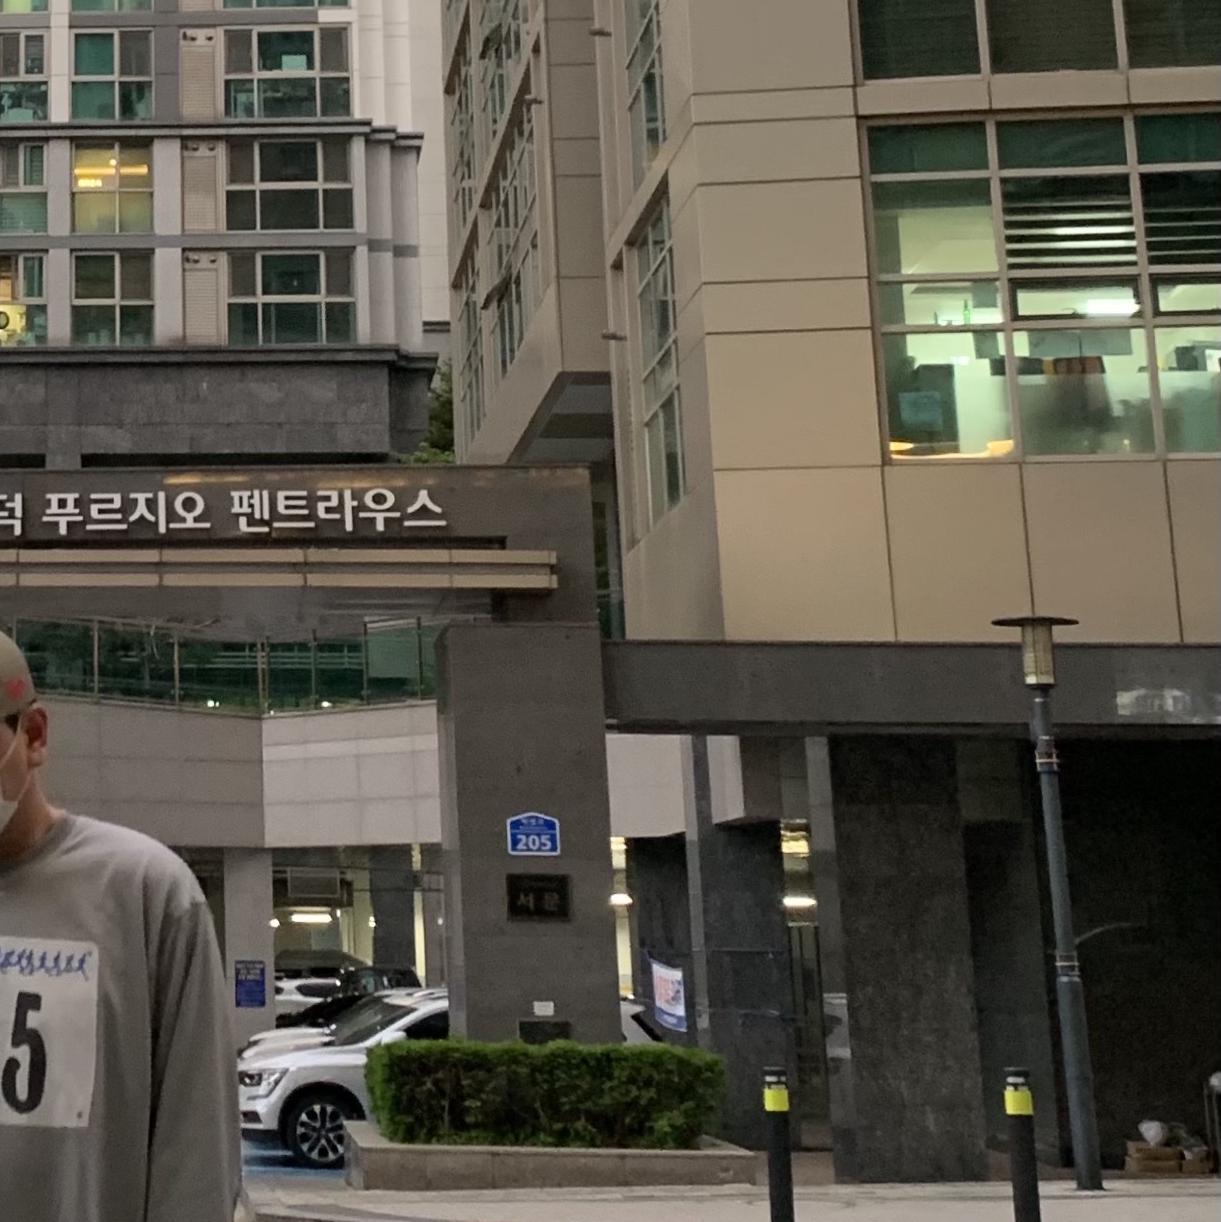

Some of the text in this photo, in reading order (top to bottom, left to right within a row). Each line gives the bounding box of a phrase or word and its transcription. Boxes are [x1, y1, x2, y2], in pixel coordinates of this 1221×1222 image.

[42, 491, 211, 536] 푸르지오
[229, 488, 448, 534] 펜트라우스
[516, 834, 552, 850] 205
